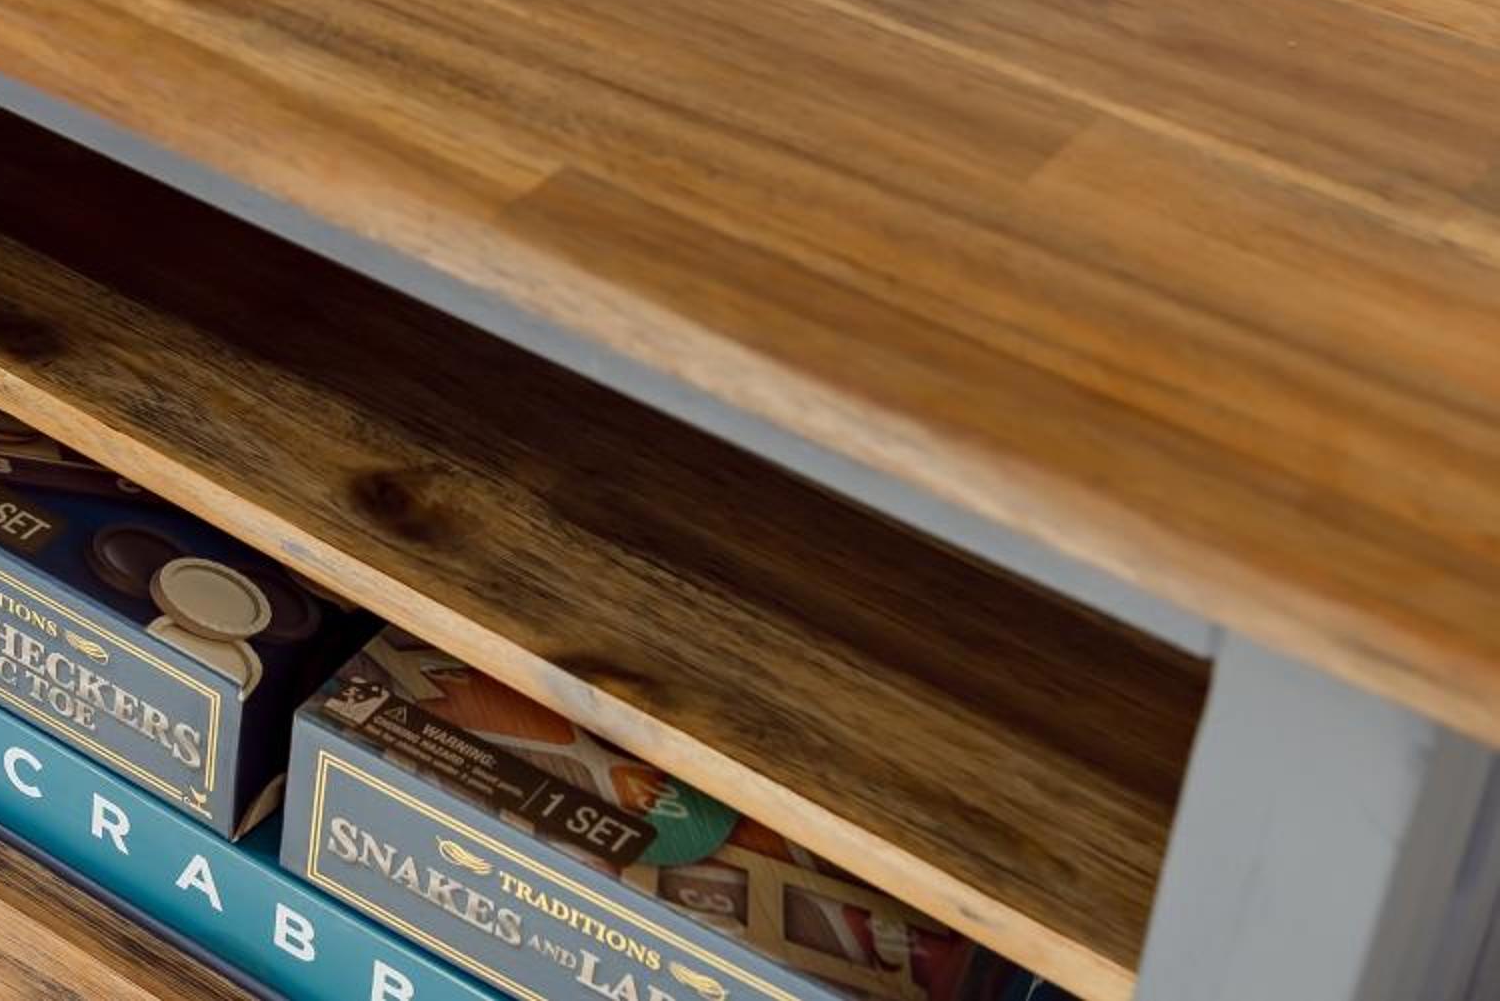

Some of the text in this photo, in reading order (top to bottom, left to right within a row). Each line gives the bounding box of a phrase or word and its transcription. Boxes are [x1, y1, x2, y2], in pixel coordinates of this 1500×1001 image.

[26, 670, 96, 731] TOE
[541, 792, 641, 853] 1 SET
[327, 816, 522, 946] SNAKES
[528, 934, 577, 970] AND
[499, 870, 662, 971] TRADITIONS
